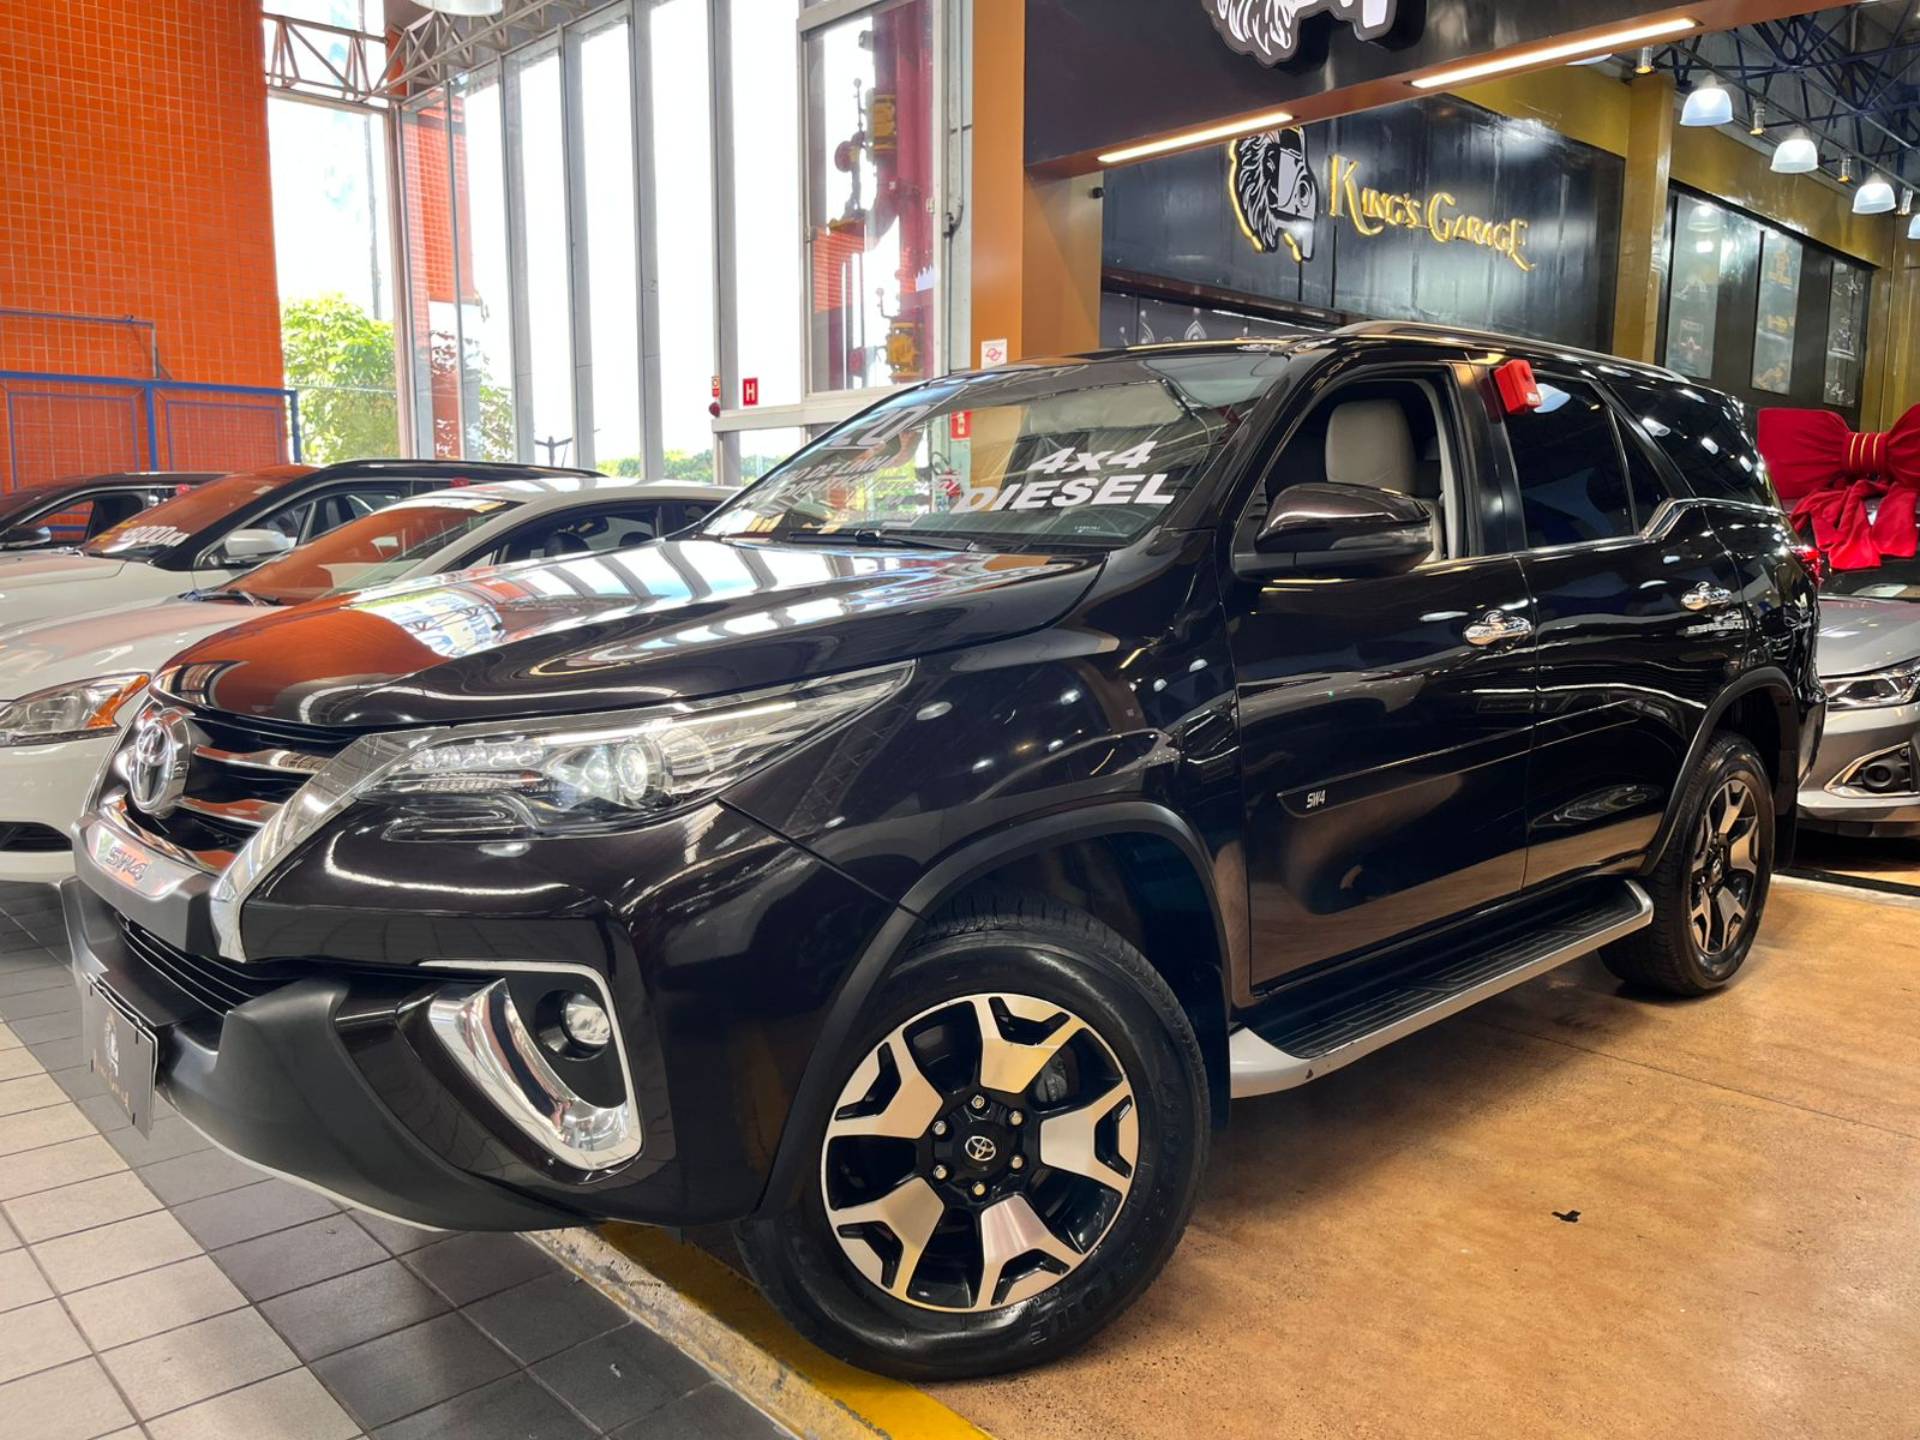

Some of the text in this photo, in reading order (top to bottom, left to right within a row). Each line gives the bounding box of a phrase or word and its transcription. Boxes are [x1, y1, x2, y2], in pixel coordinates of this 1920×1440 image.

[1427, 191, 1535, 272] GARAGE
[745, 383, 756, 402] H
[950, 472, 1176, 515] DIESEL
